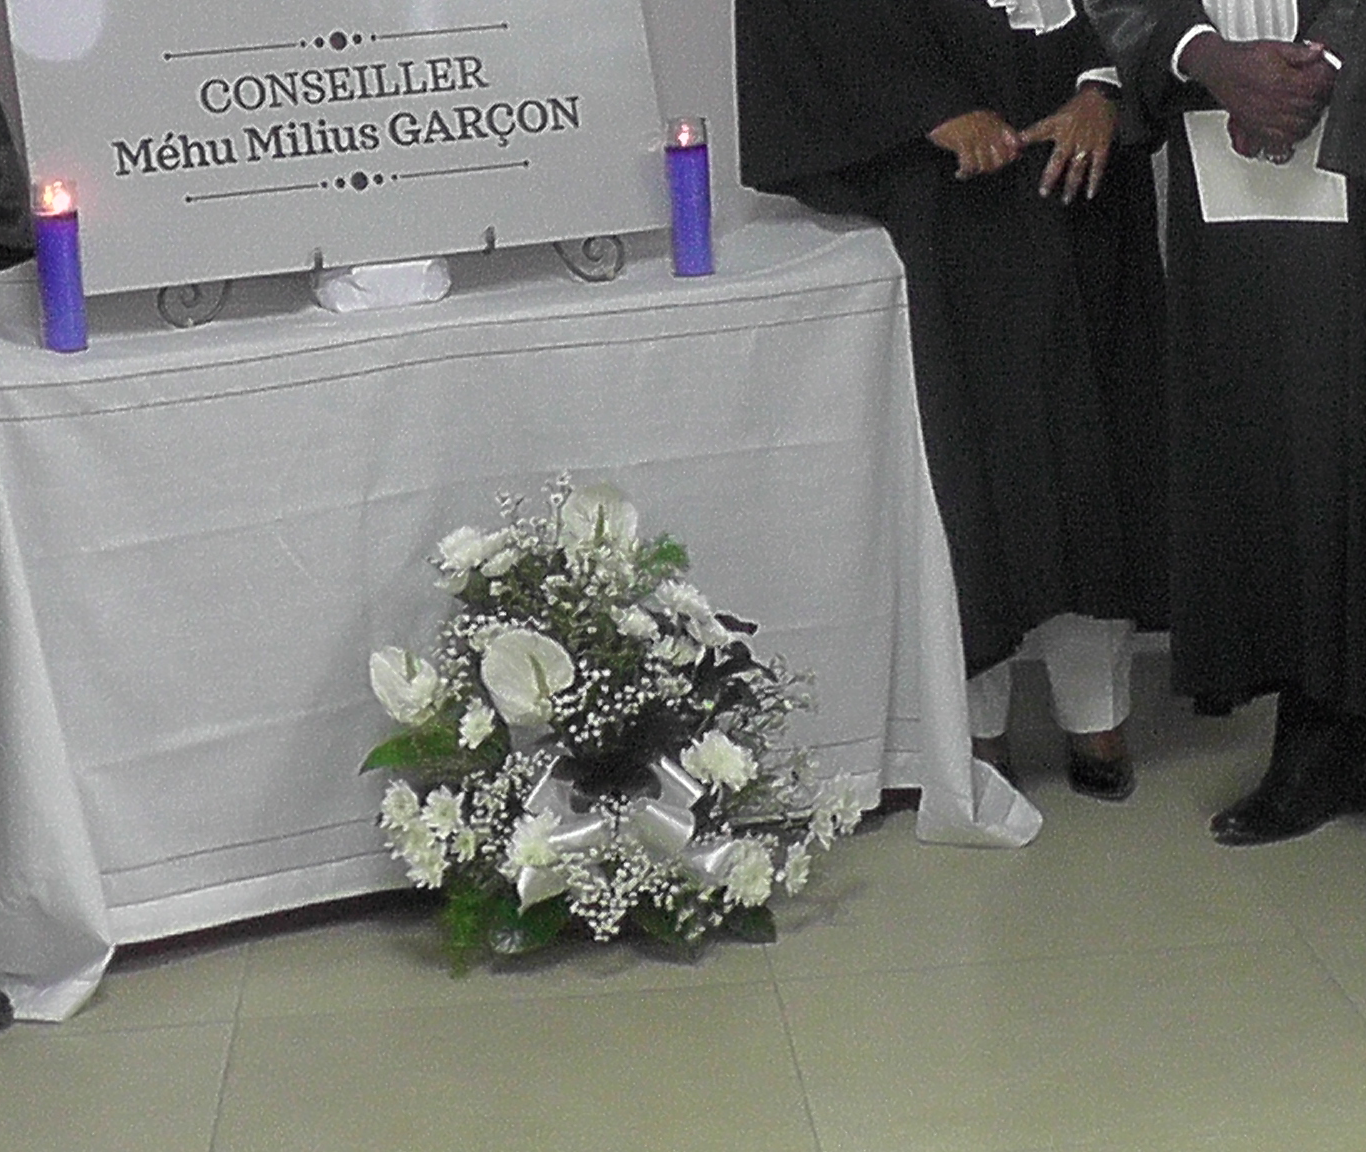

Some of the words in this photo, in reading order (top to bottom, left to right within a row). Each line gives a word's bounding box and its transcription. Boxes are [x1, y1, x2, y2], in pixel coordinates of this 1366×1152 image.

[200, 56, 489, 113] CONSEILLER
[113, 132, 237, 176] Méhu
[243, 119, 380, 163] Milius
[388, 96, 581, 147] GARÇON
